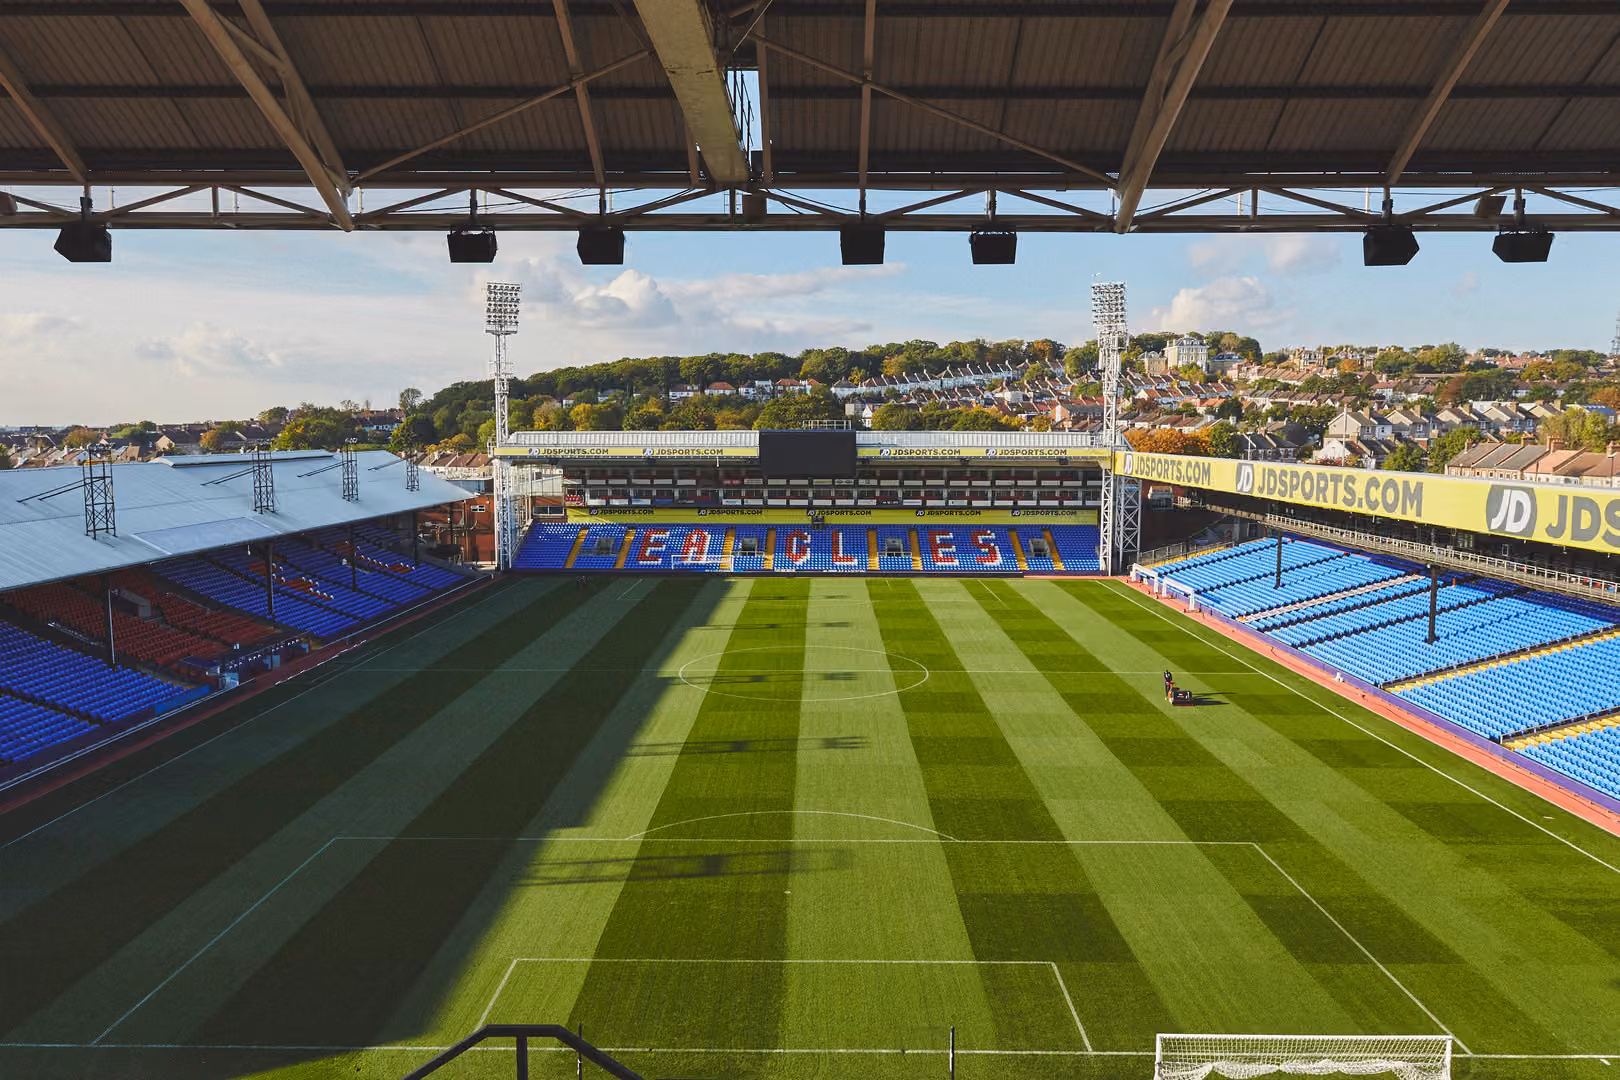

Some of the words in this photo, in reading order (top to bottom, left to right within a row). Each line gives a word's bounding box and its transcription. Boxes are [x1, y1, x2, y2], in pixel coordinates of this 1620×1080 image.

[1135, 455, 1211, 486] JDSPORTS.COM
[1258, 466, 1424, 518] JDSPORTS.COM
[1490, 488, 1532, 533] JD
